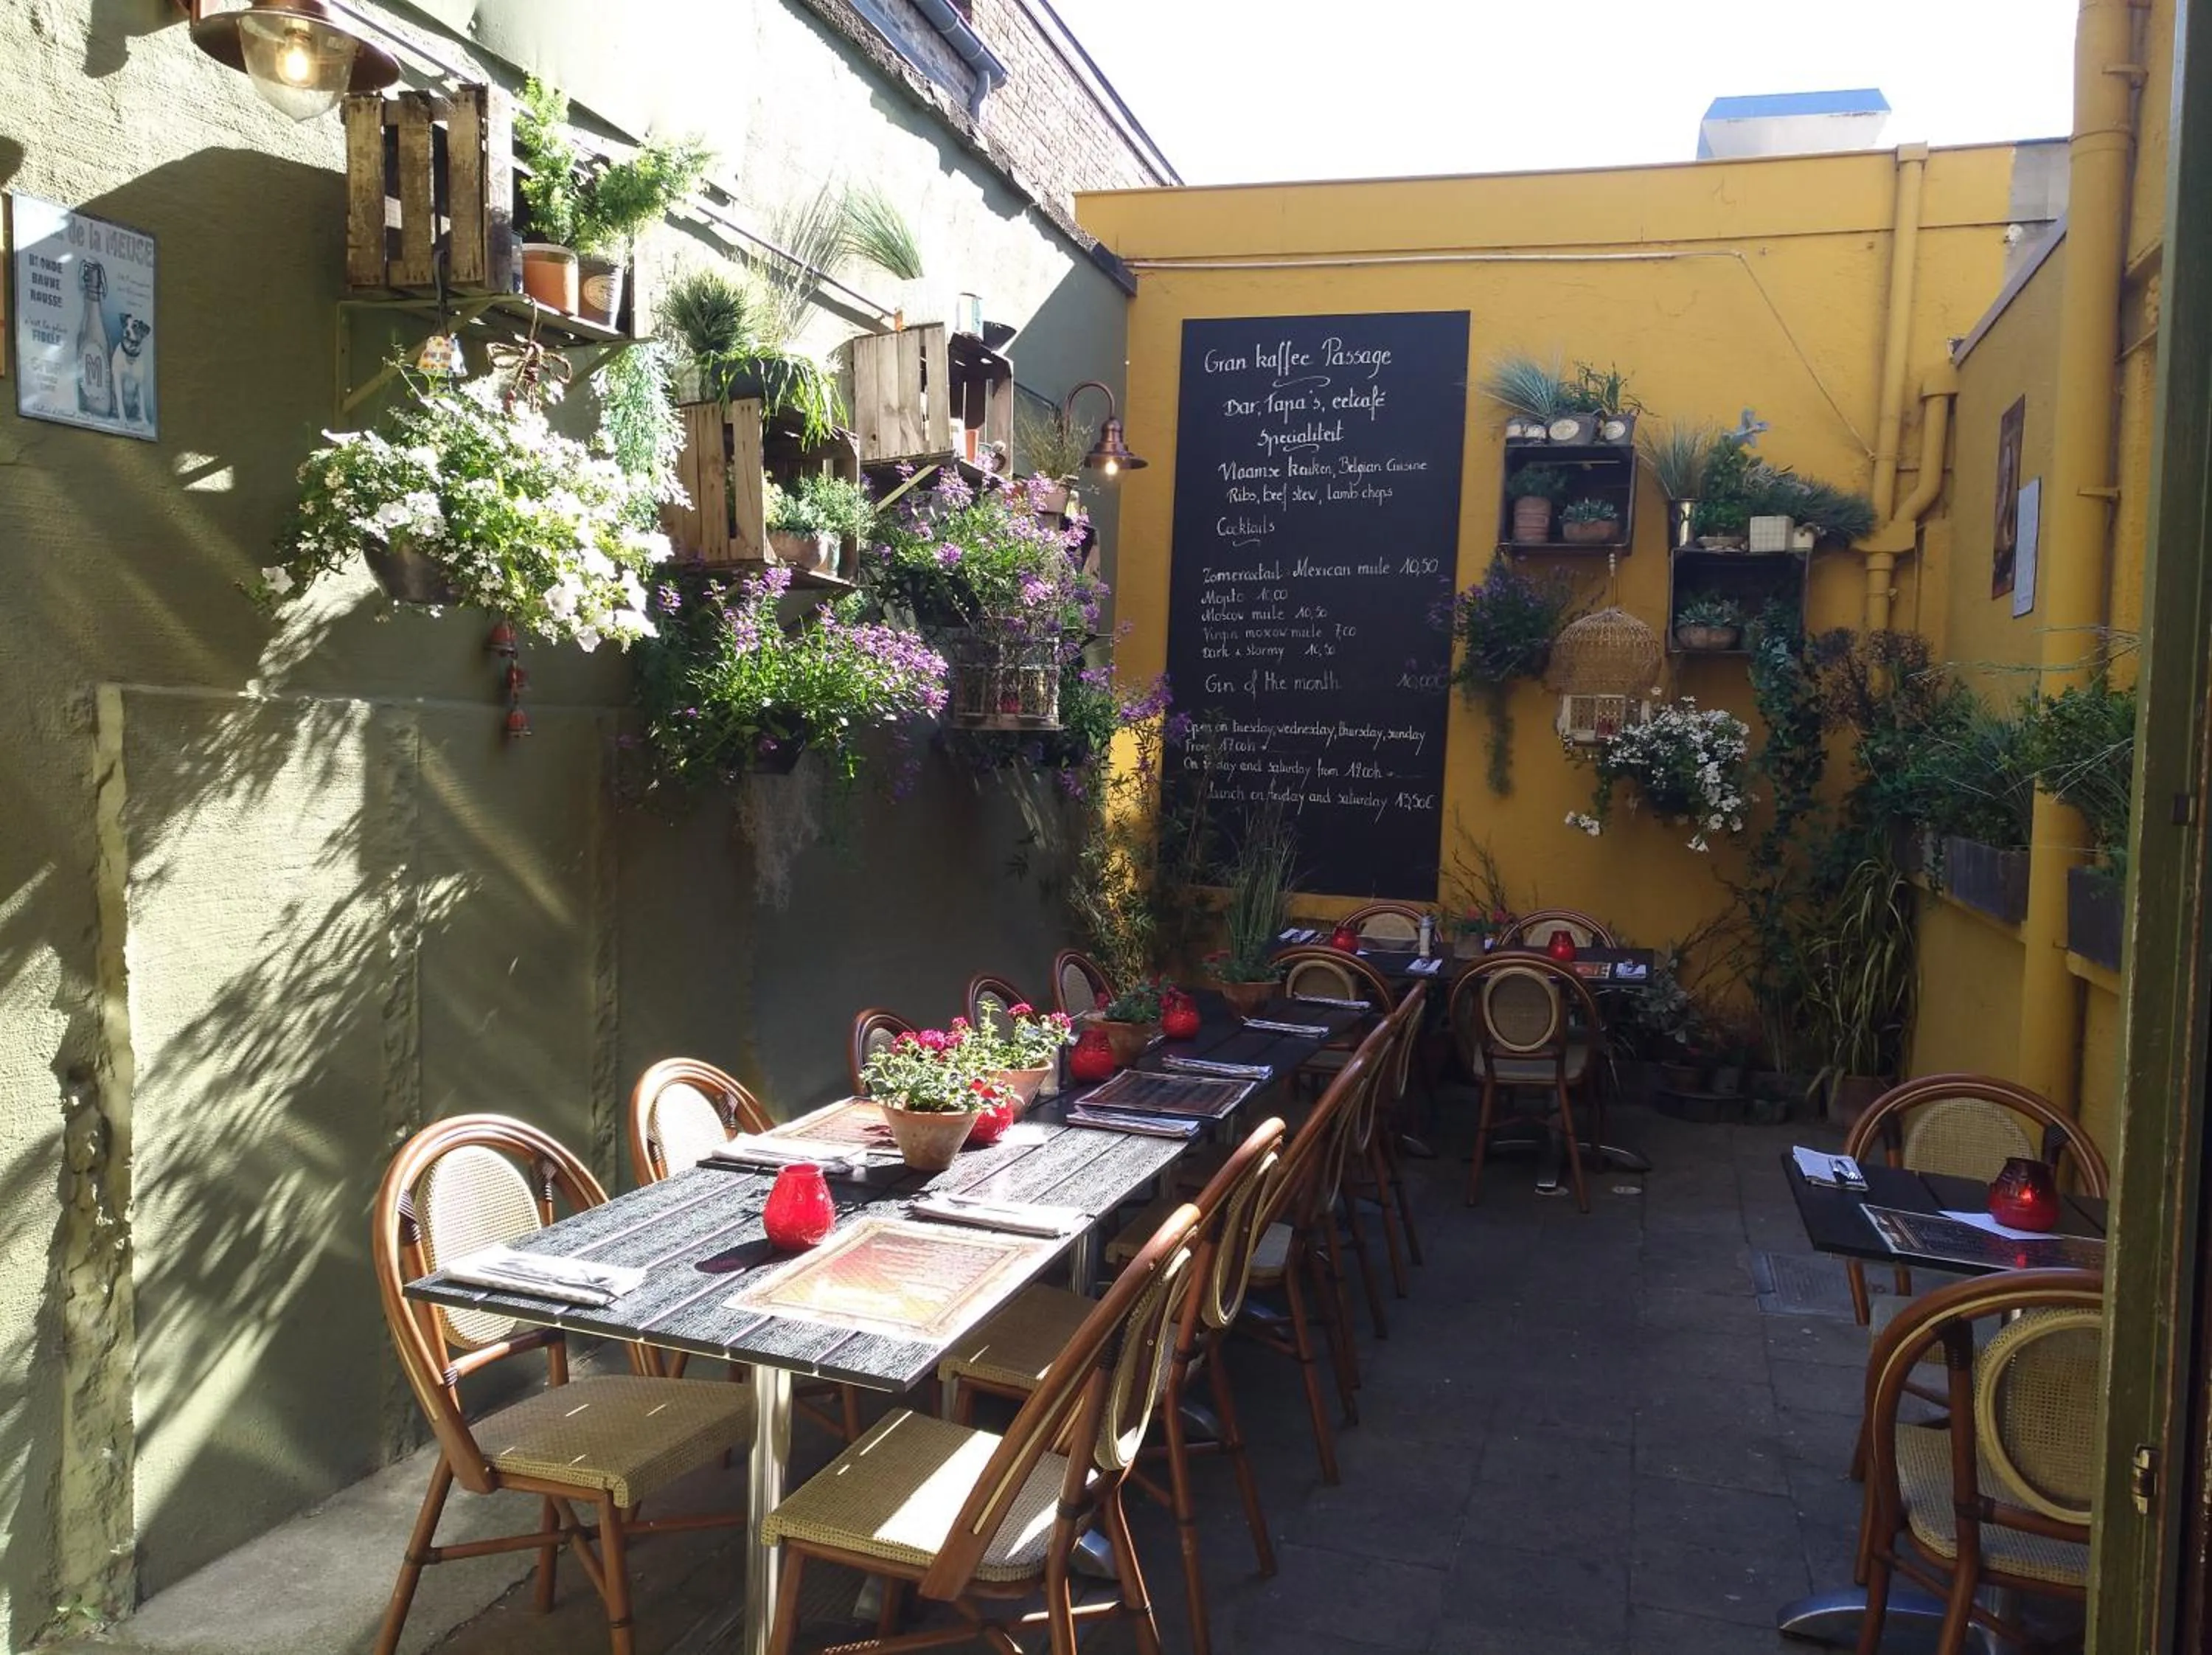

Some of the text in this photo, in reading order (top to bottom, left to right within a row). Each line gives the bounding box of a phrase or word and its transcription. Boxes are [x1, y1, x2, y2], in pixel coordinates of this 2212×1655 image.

[68, 216, 85, 247] de
[89, 222, 102, 252] la
[1256, 341, 1313, 376] kaffee
[1321, 337, 1392, 378] Passage
[1257, 419, 1345, 457] Specialiteit
[1339, 455, 1382, 486] Belgian
[1263, 482, 1287, 512] beef
[1362, 483, 1393, 507] chops
[1217, 516, 1276, 537] Cocktails
[1293, 556, 1351, 577] Mexican
[1357, 556, 1391, 575] mule
[1399, 556, 1439, 577] 10,50
[1201, 588, 1244, 612] Mojito
[1252, 605, 1284, 620] mule
[1291, 623, 1322, 638] mule
[1206, 674, 1234, 693] Gin
[1244, 669, 1258, 699] of
[1294, 670, 1340, 691] month
[1308, 785, 1331, 803] and
